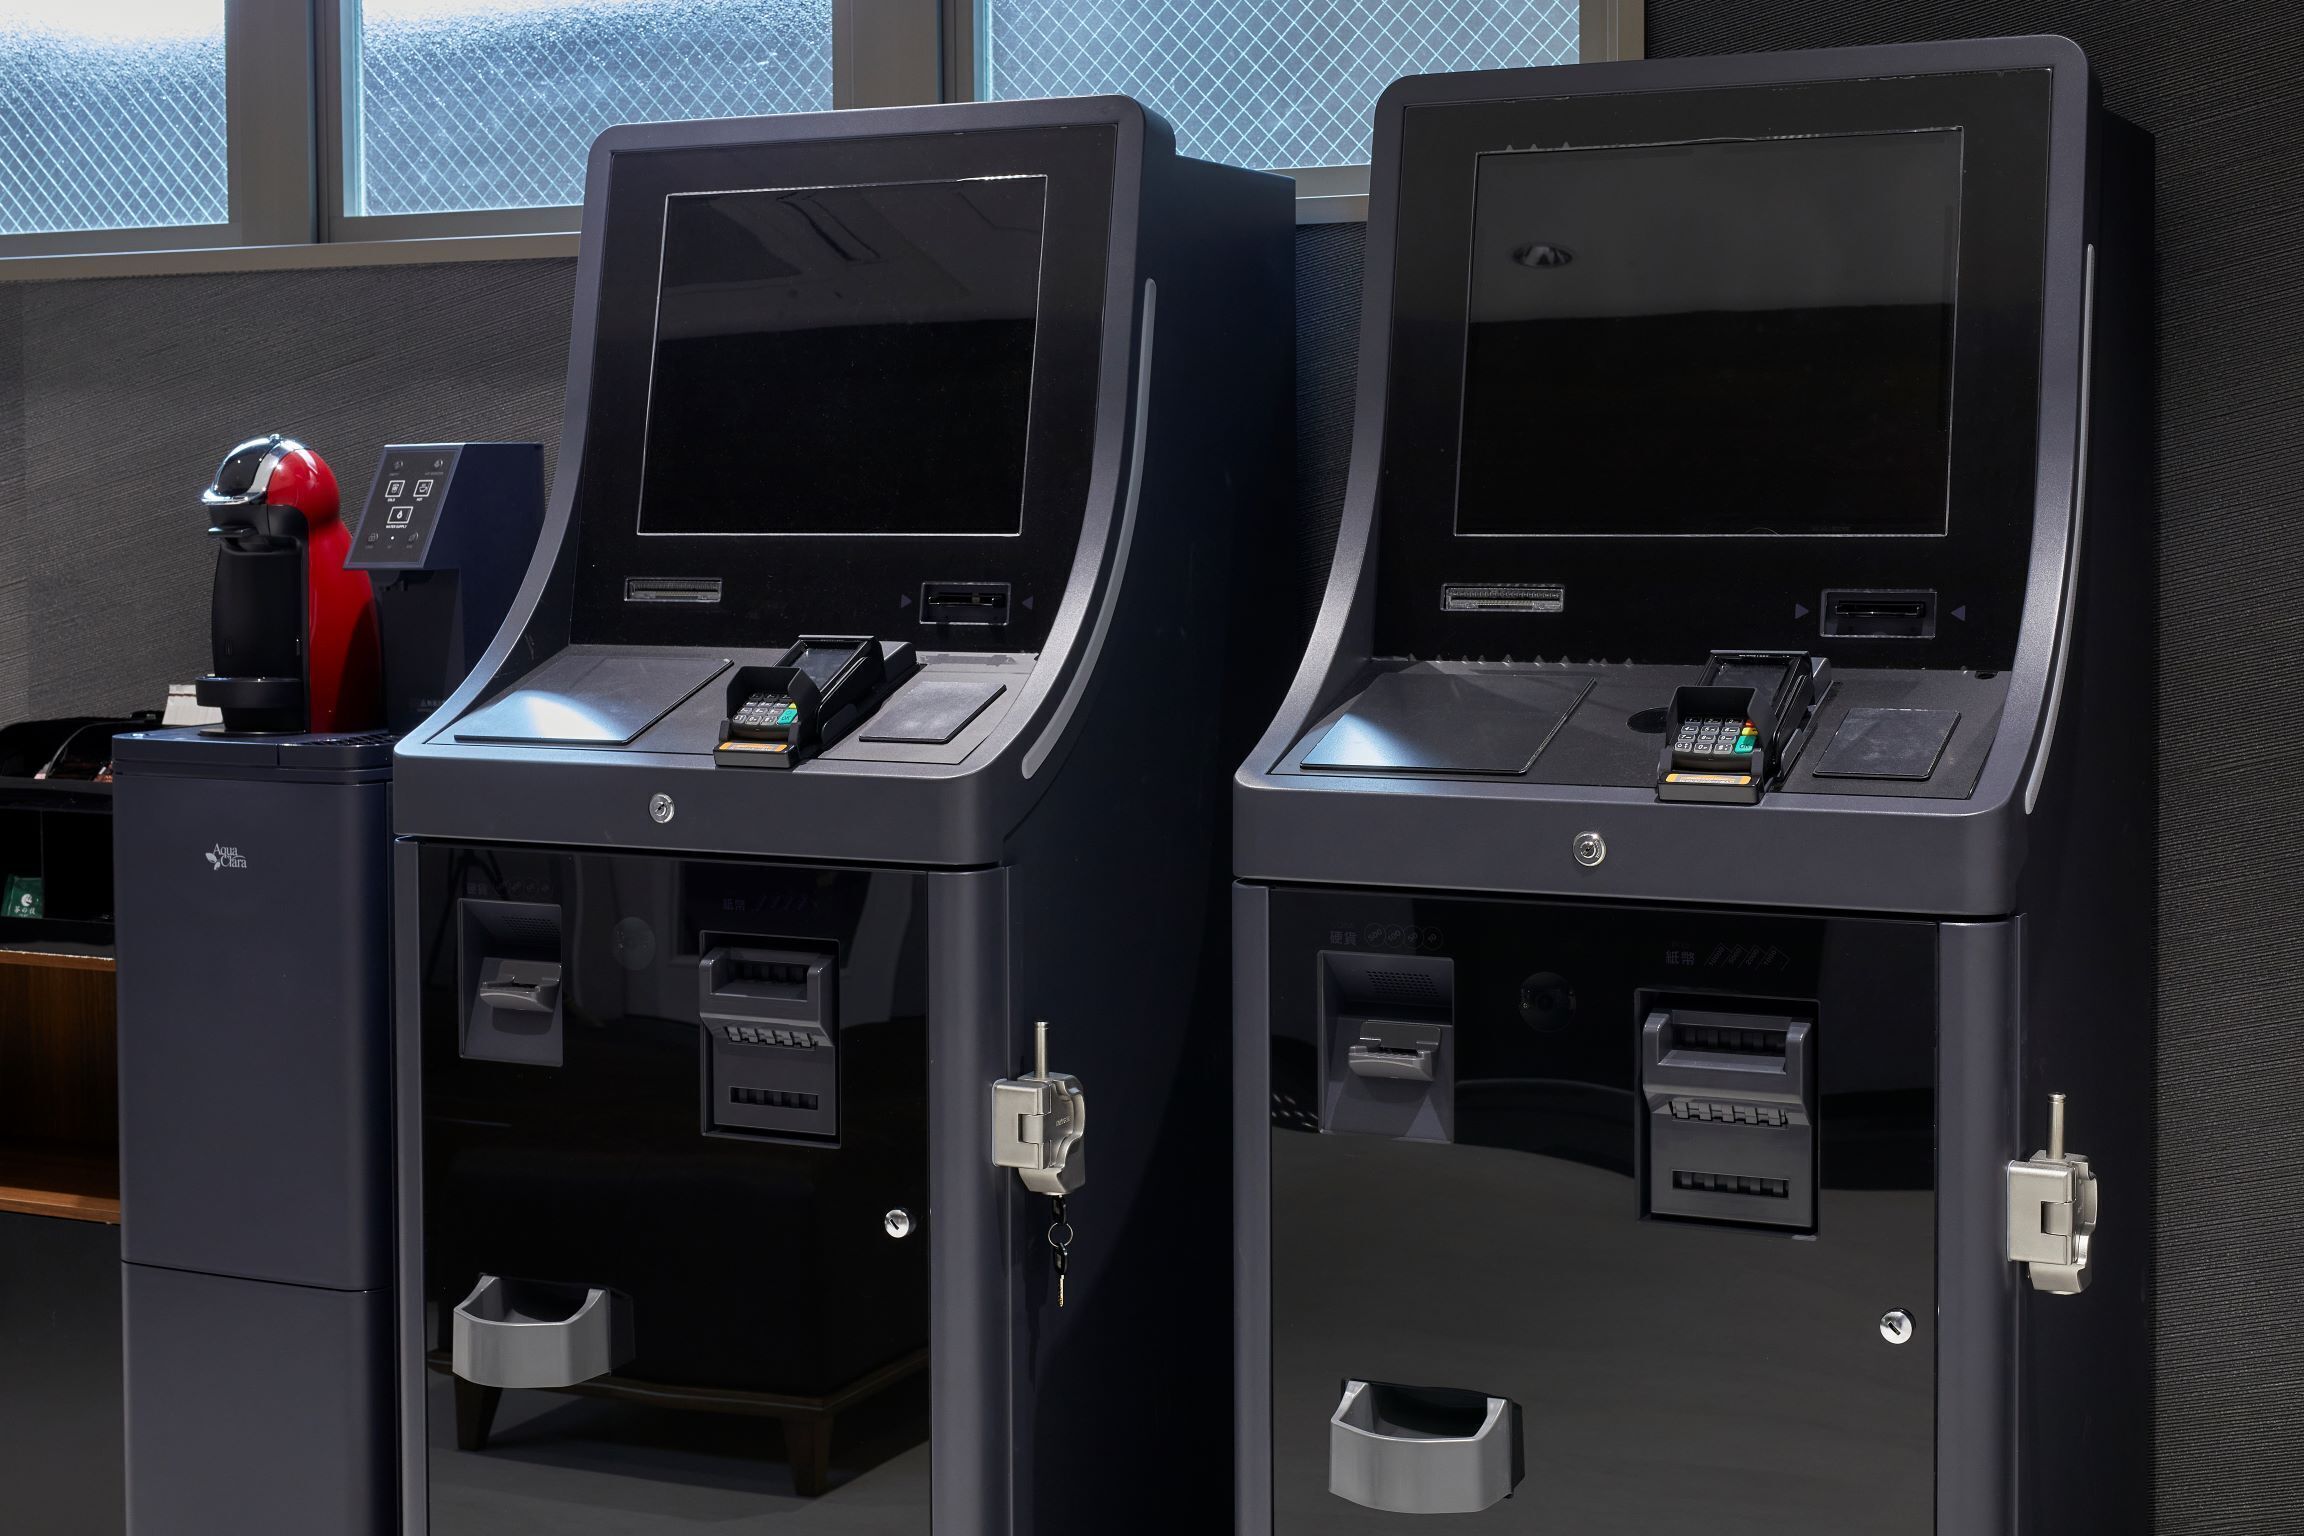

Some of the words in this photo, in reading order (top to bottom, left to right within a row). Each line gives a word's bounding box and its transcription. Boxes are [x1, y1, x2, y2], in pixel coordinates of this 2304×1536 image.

[212, 843, 238, 858] Aqua
[220, 855, 247, 869] Clara
[1329, 930, 1358, 946] 硬貨
[1665, 949, 1696, 966] 紙幣
